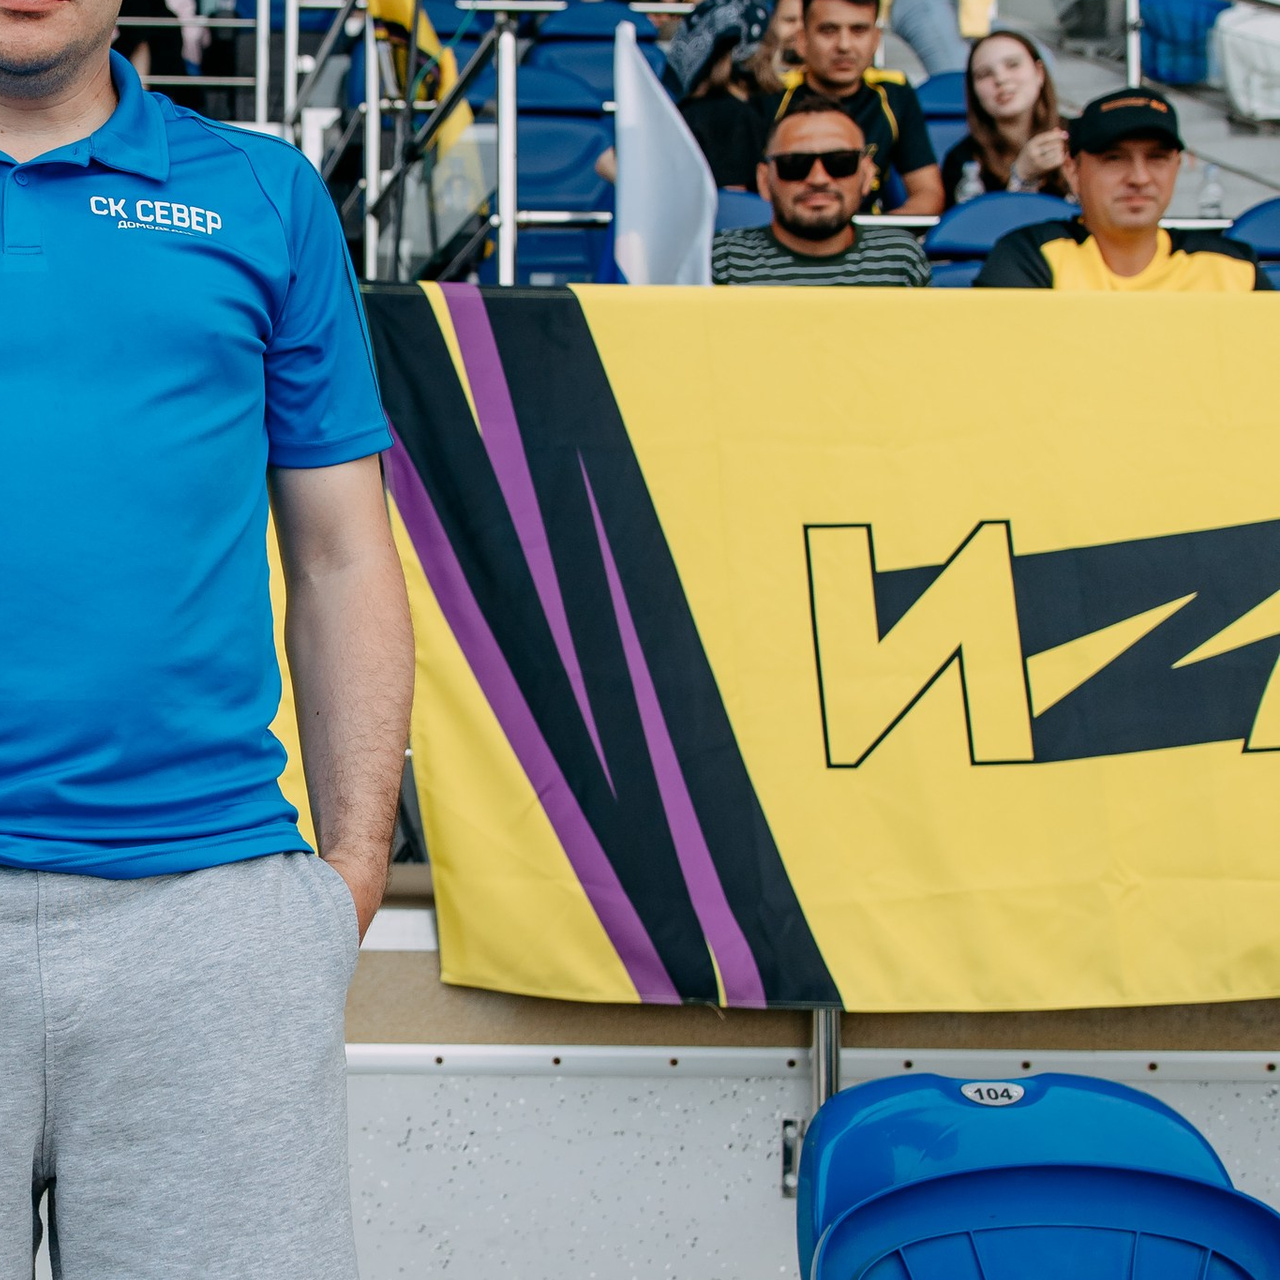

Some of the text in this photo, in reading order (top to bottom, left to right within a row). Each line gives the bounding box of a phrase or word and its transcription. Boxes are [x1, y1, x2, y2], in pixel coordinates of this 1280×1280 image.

[89, 195, 223, 235] СК СЕВЕР
[973, 1087, 1014, 1101] 104
